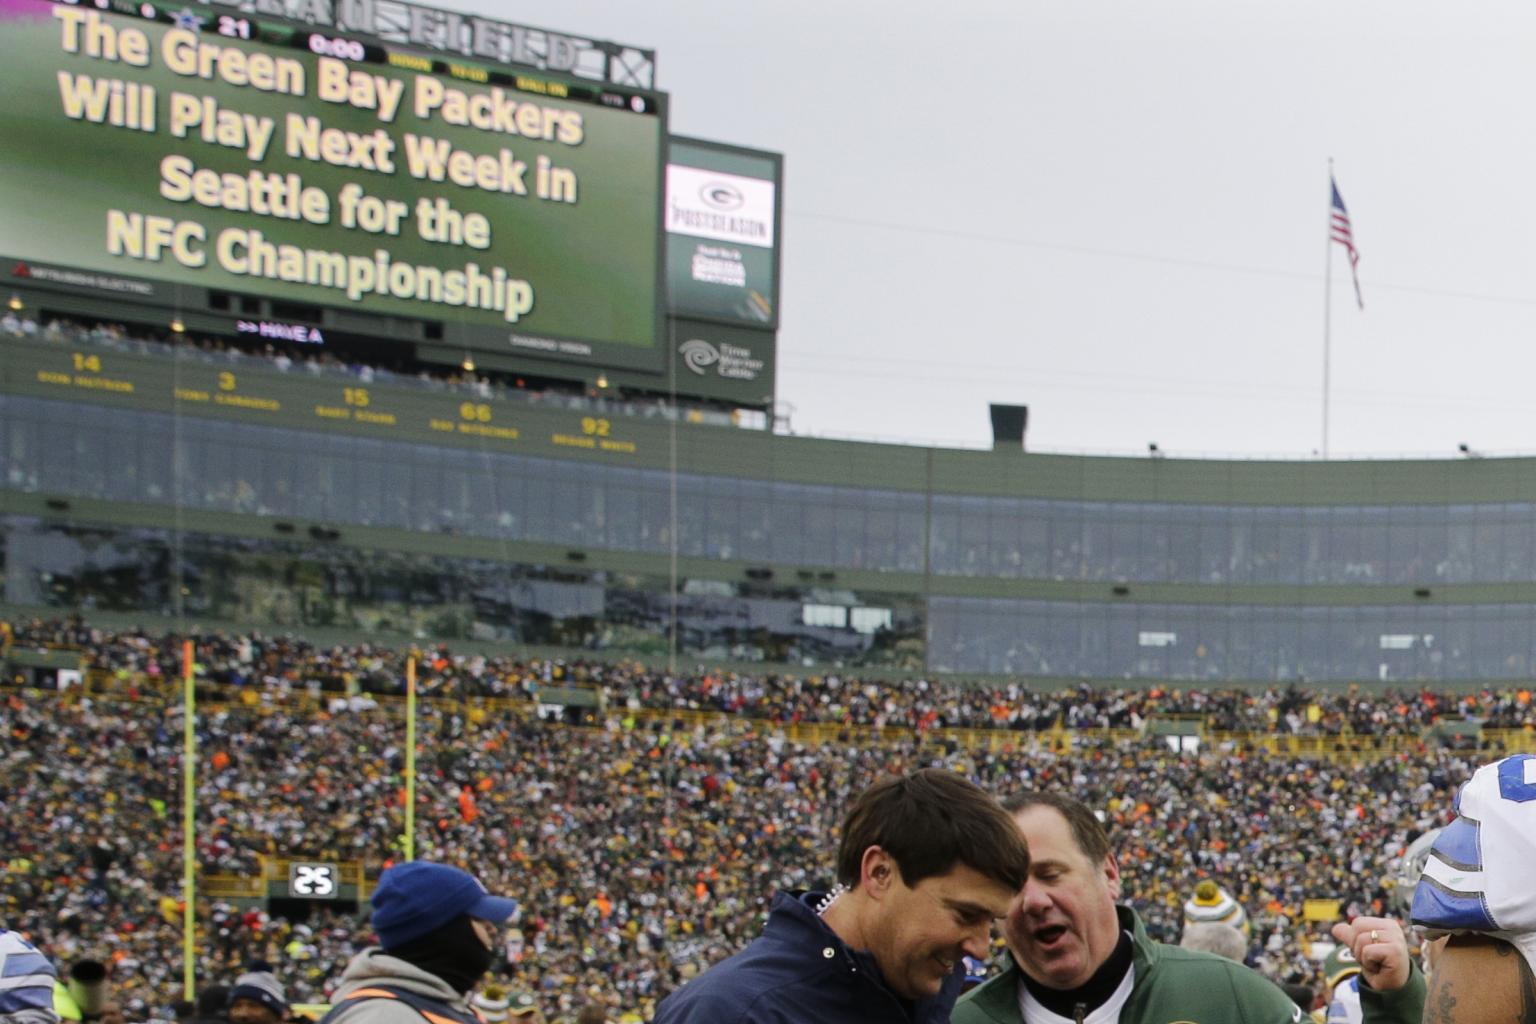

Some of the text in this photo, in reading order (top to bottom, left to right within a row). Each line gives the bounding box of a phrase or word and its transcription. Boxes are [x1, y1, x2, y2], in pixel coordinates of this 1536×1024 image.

[218, 16, 249, 39] 21
[52, 5, 584, 146] The Green Bay Packers
[57, 70, 577, 203] Will Play Next Week in
[160, 155, 490, 249] Seattle for the
[107, 209, 533, 323] NFC Championship
[72, 353, 101, 372] 14
[218, 372, 236, 390] 3
[343, 388, 369, 407] 15
[581, 417, 610, 436] 92
